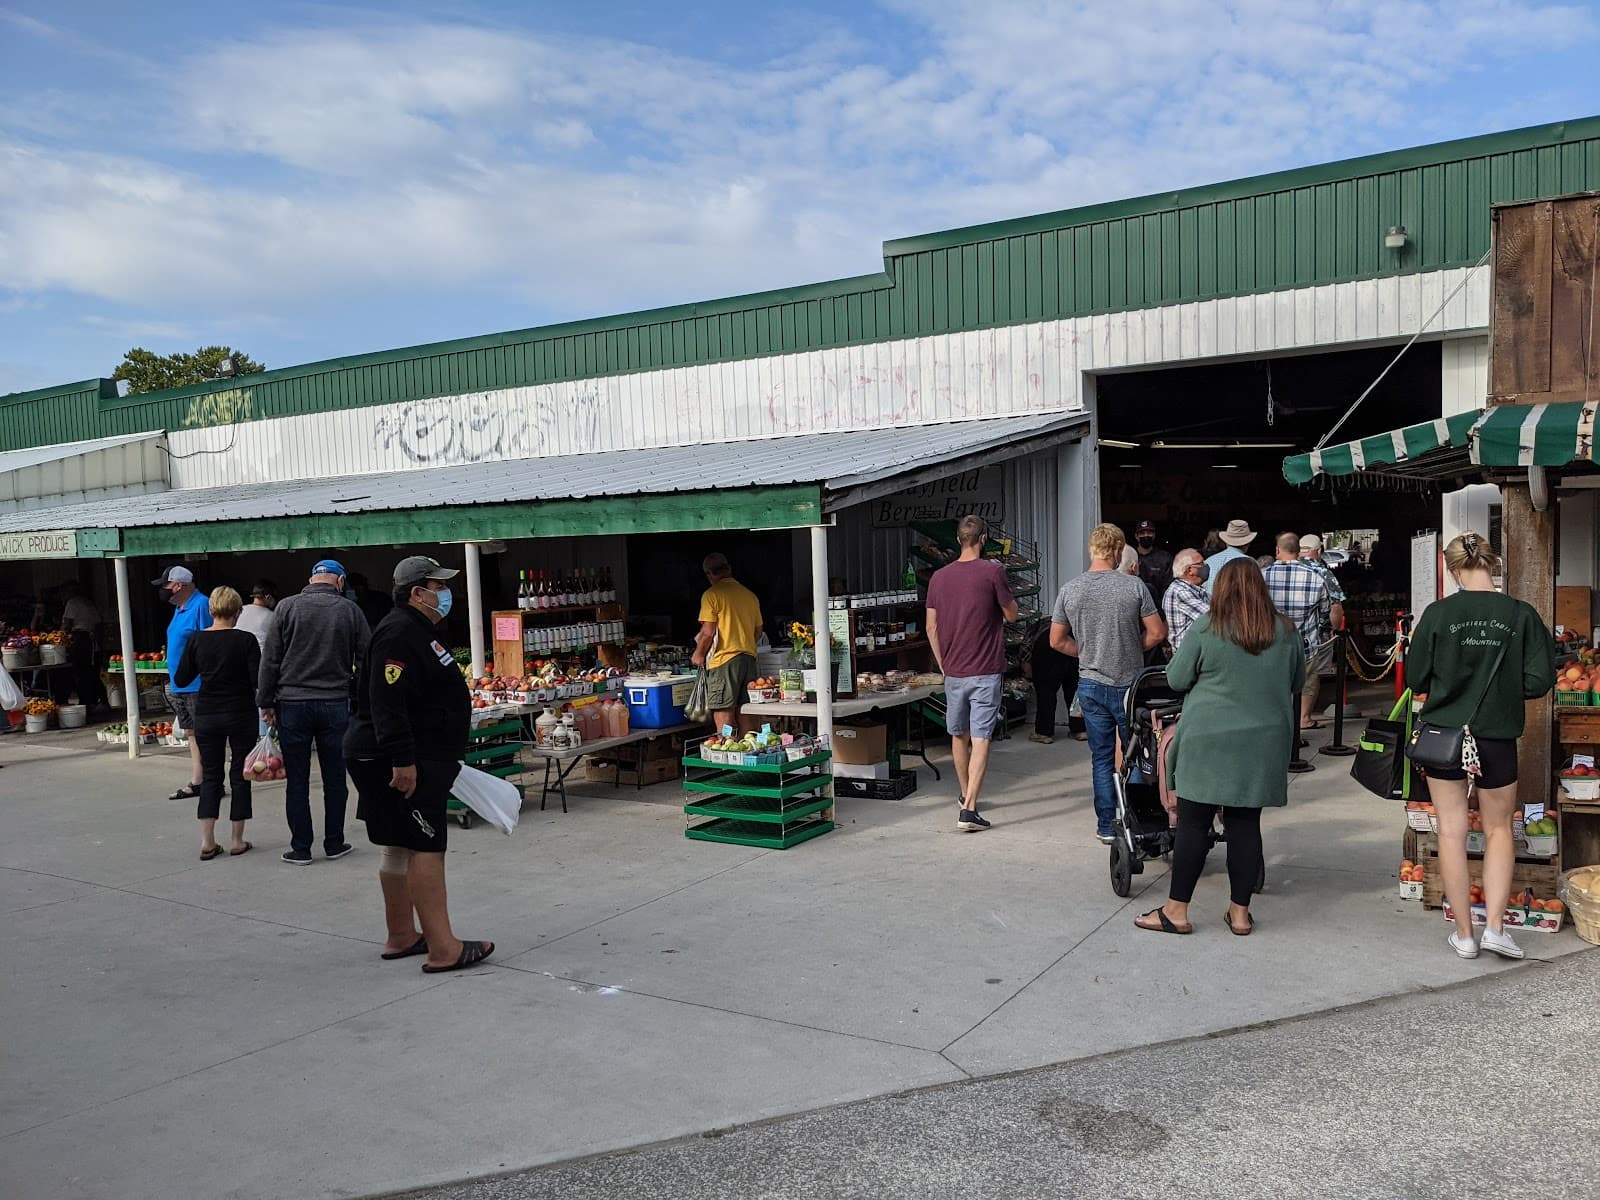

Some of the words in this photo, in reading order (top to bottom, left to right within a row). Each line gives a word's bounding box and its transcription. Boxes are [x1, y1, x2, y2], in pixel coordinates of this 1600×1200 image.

[891, 470, 980, 498] ayfield
[944, 498, 997, 518] Farm
[0, 538, 24, 554] WICK
[29, 536, 69, 553] PRODUCE
